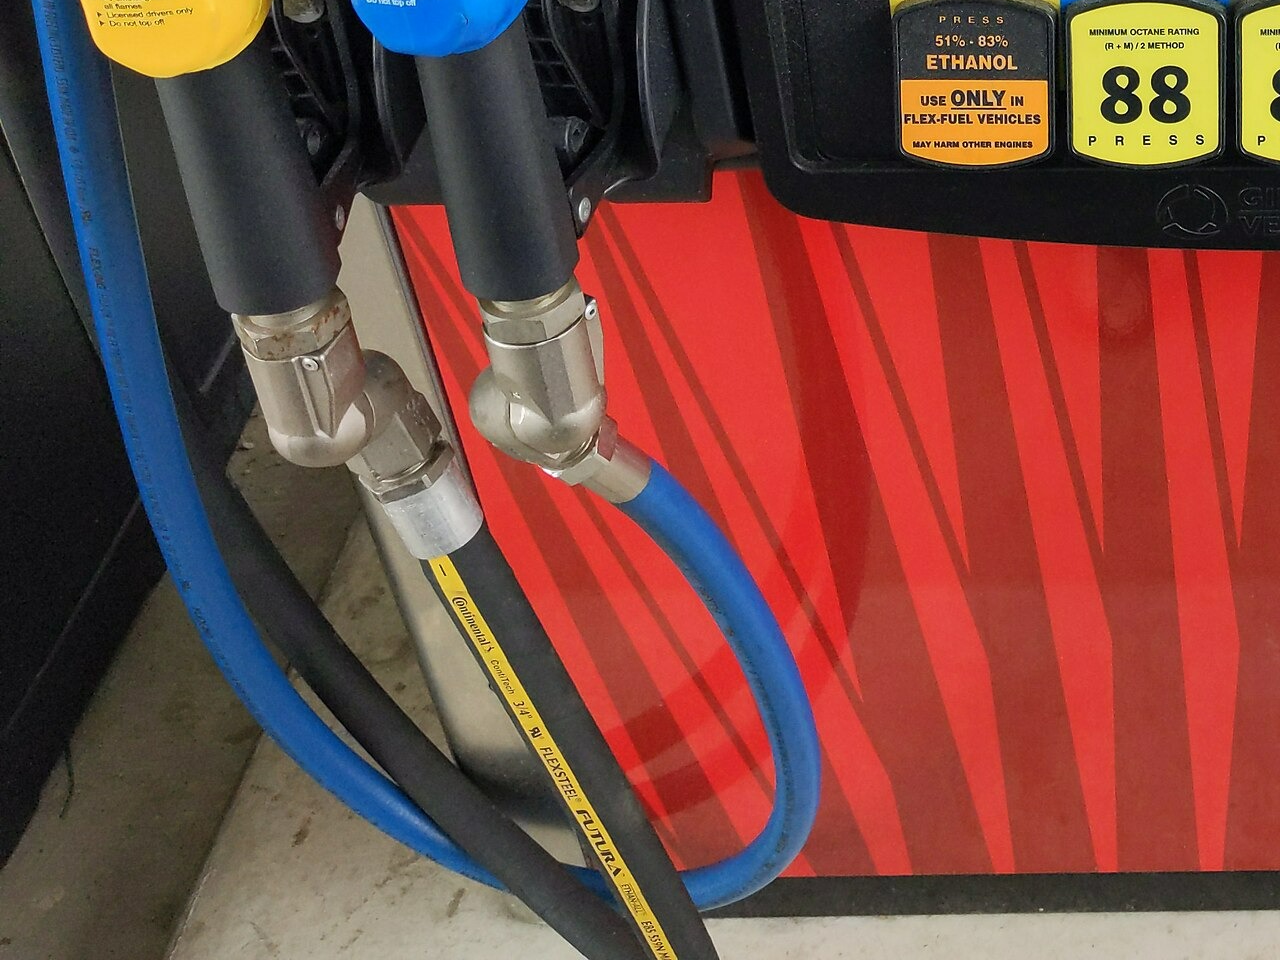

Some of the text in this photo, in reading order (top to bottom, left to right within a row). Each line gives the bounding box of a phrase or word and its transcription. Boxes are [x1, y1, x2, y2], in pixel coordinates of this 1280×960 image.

[1089, 28, 1200, 36] MINIMUM OCTANE RATING
[935, 34, 1009, 47] 51% 83%
[1147, 41, 1185, 50] METHOD
[926, 54, 1018, 70] ETHANOL
[920, 89, 1024, 107] USE ONLY IN
[1100, 65, 1191, 124] 88
[904, 113, 1041, 125] FLEX-FUEL VEHICLES
[912, 141, 1033, 149] MAY HARM OTHER ENGINES
[489, 658, 516, 695] ContiTech
[575, 808, 621, 878] FUTURA
